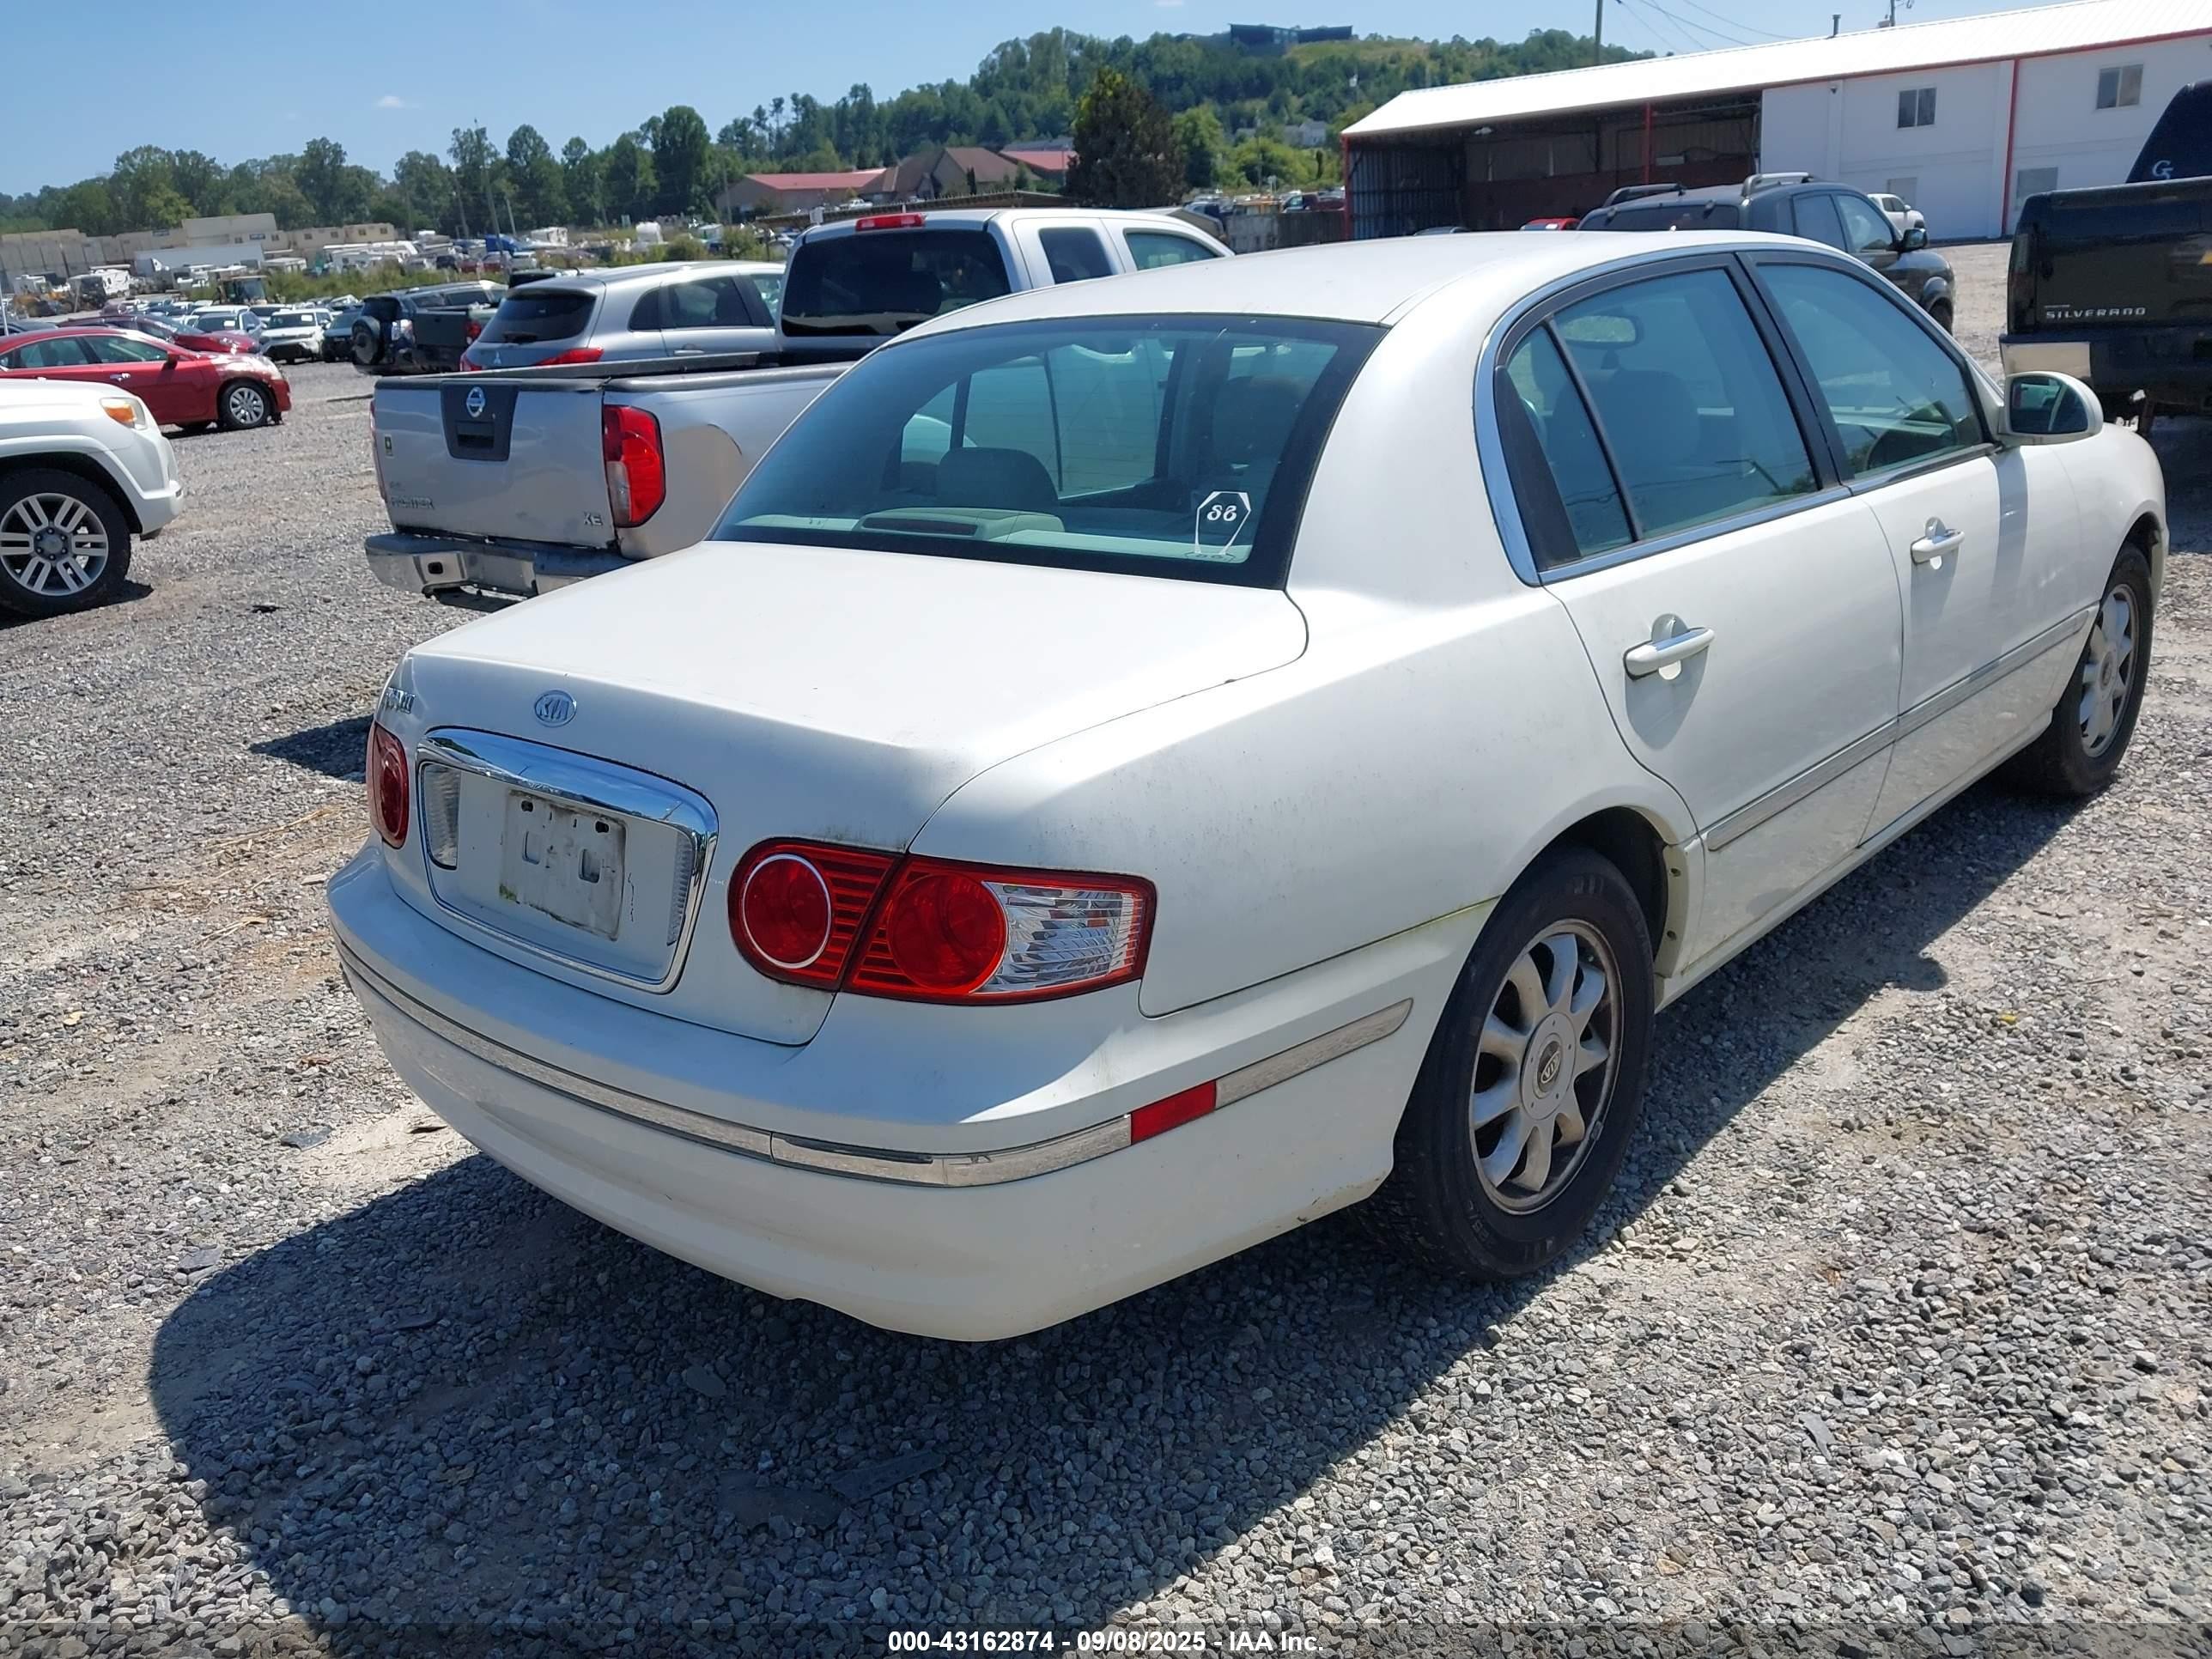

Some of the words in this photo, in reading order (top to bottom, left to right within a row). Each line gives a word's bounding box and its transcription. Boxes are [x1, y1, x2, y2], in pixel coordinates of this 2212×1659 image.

[2045, 307, 2146, 319] SILVERADO
[584, 511, 603, 526] XE
[538, 696, 571, 722] KIA
